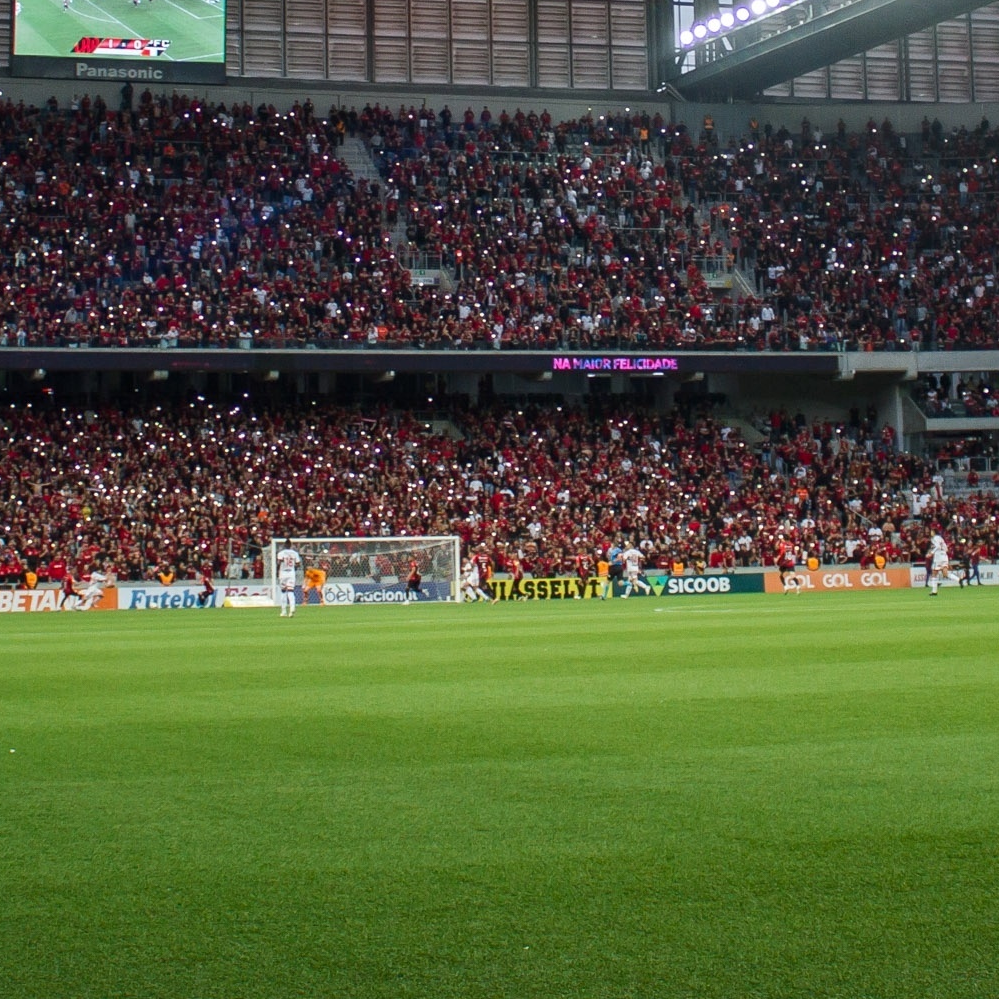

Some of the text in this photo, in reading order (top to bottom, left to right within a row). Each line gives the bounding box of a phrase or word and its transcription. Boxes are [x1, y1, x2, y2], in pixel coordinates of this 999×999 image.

[76, 62, 163, 79] Panasonic
[553, 358, 678, 370] NA MAIOR FELICIDADE
[668, 576, 731, 594] SICOOB
[822, 573, 853, 588] GOL
[860, 571, 891, 587] GOL
